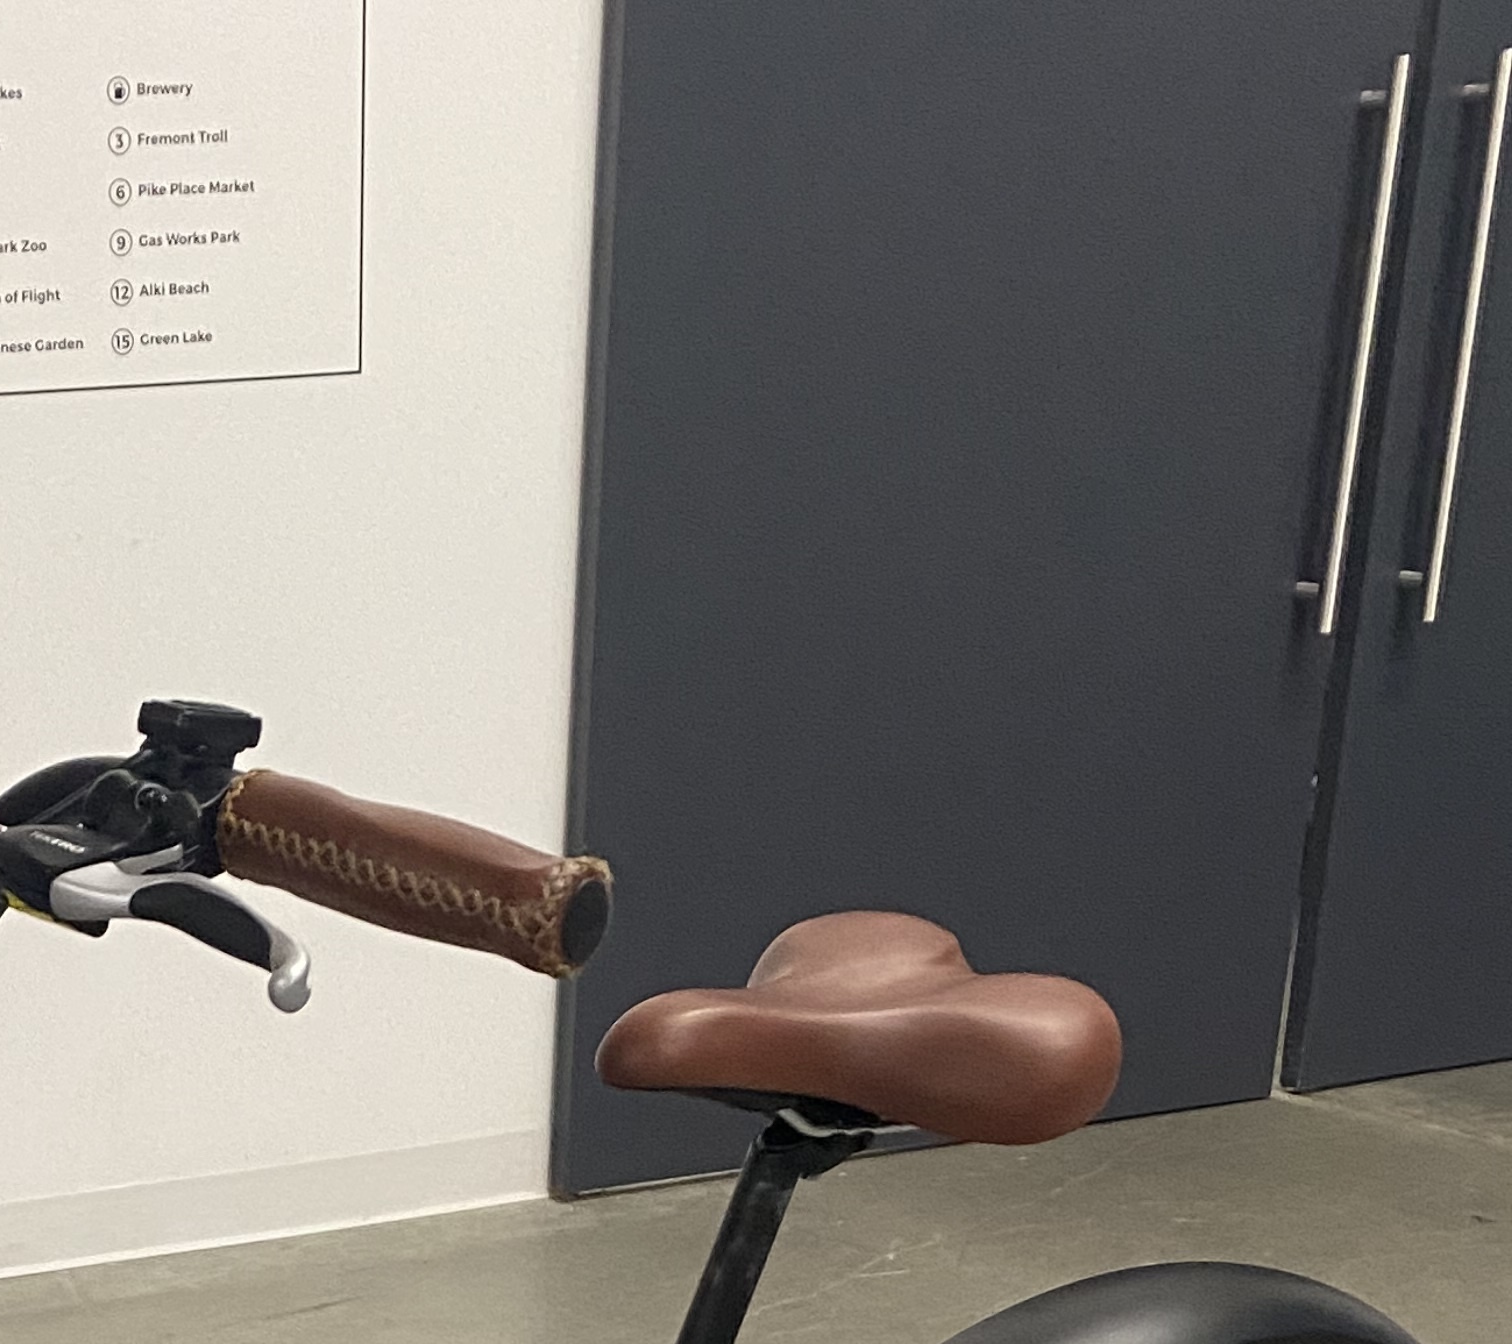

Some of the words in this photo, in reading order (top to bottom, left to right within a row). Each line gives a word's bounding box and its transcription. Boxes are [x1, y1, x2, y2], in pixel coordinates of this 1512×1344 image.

[137, 83, 193, 96] Brewery
[138, 132, 195, 145] Fremont
[198, 129, 228, 143] Troll
[138, 183, 166, 196] Pike
[170, 182, 205, 195] Place
[209, 179, 254, 193] Market
[21, 239, 47, 253] Zoo
[139, 235, 162, 247] Gas
[166, 232, 207, 245] Works
[211, 230, 240, 243] Park
[5, 290, 18, 304] of
[22, 288, 61, 304] Flight
[140, 282, 165, 296] Alki
[169, 281, 209, 295] Beach
[35, 337, 84, 351] Garden
[140, 333, 179, 345] Green
[183, 330, 212, 343] Lake
